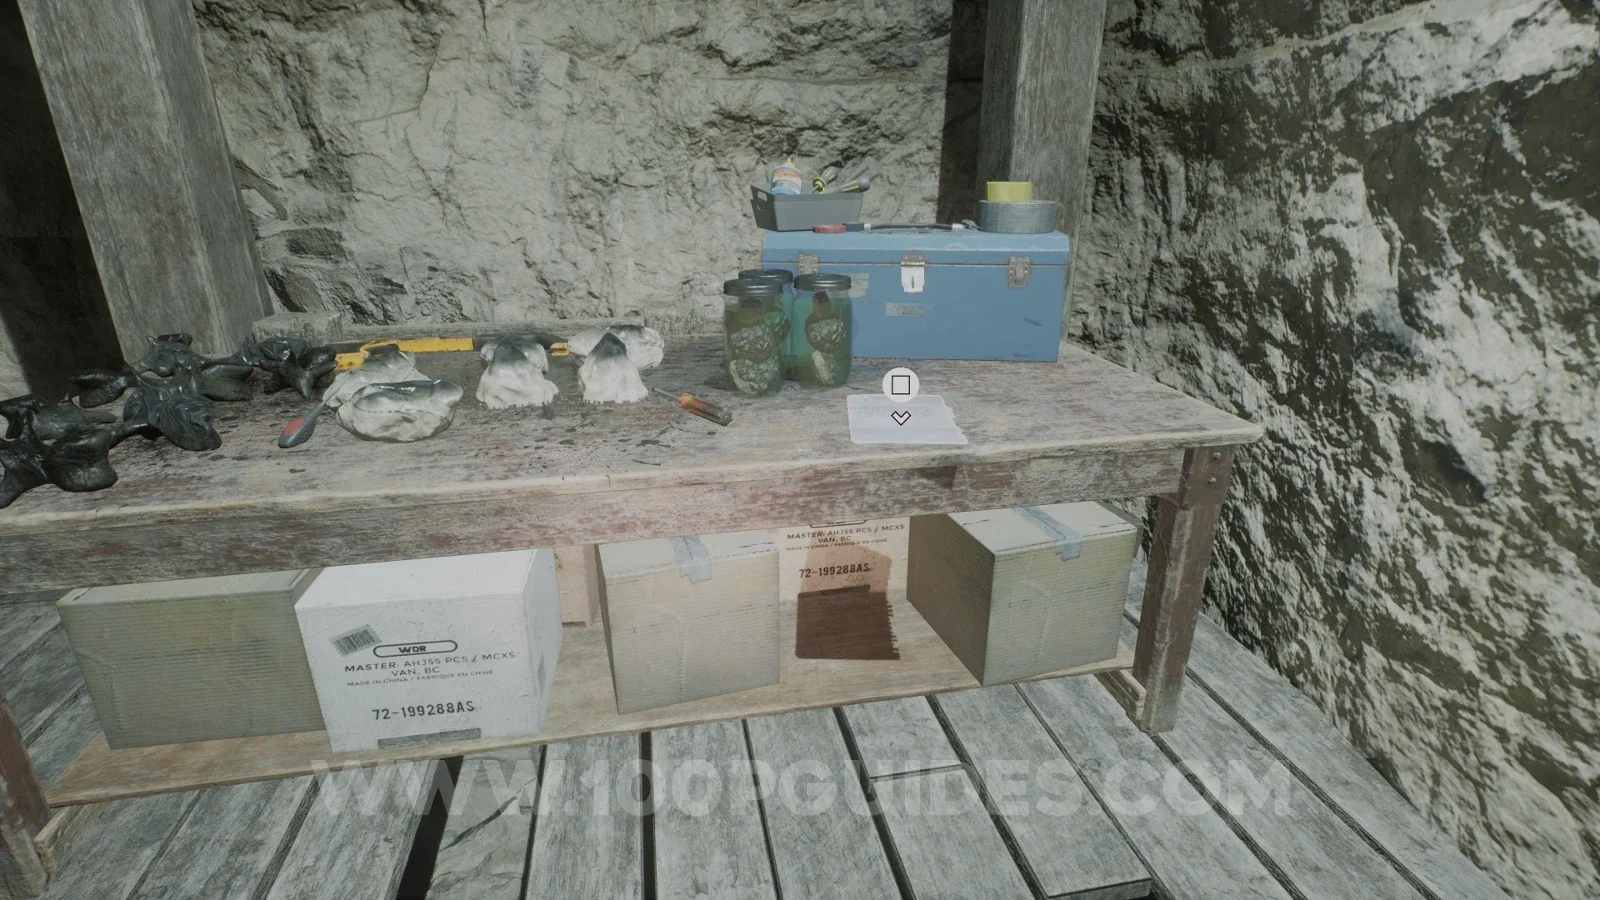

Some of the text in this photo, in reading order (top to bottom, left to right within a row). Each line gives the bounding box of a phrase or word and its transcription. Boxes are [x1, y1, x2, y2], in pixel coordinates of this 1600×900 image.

[799, 562, 870, 578] 72-199288AS
[398, 645, 427, 654] WDR
[344, 661, 399, 672] MASTER:
[445, 655, 468, 664] PCS
[417, 672, 455, 680] FABRIQUE
[372, 700, 476, 720] 72-199288AS
